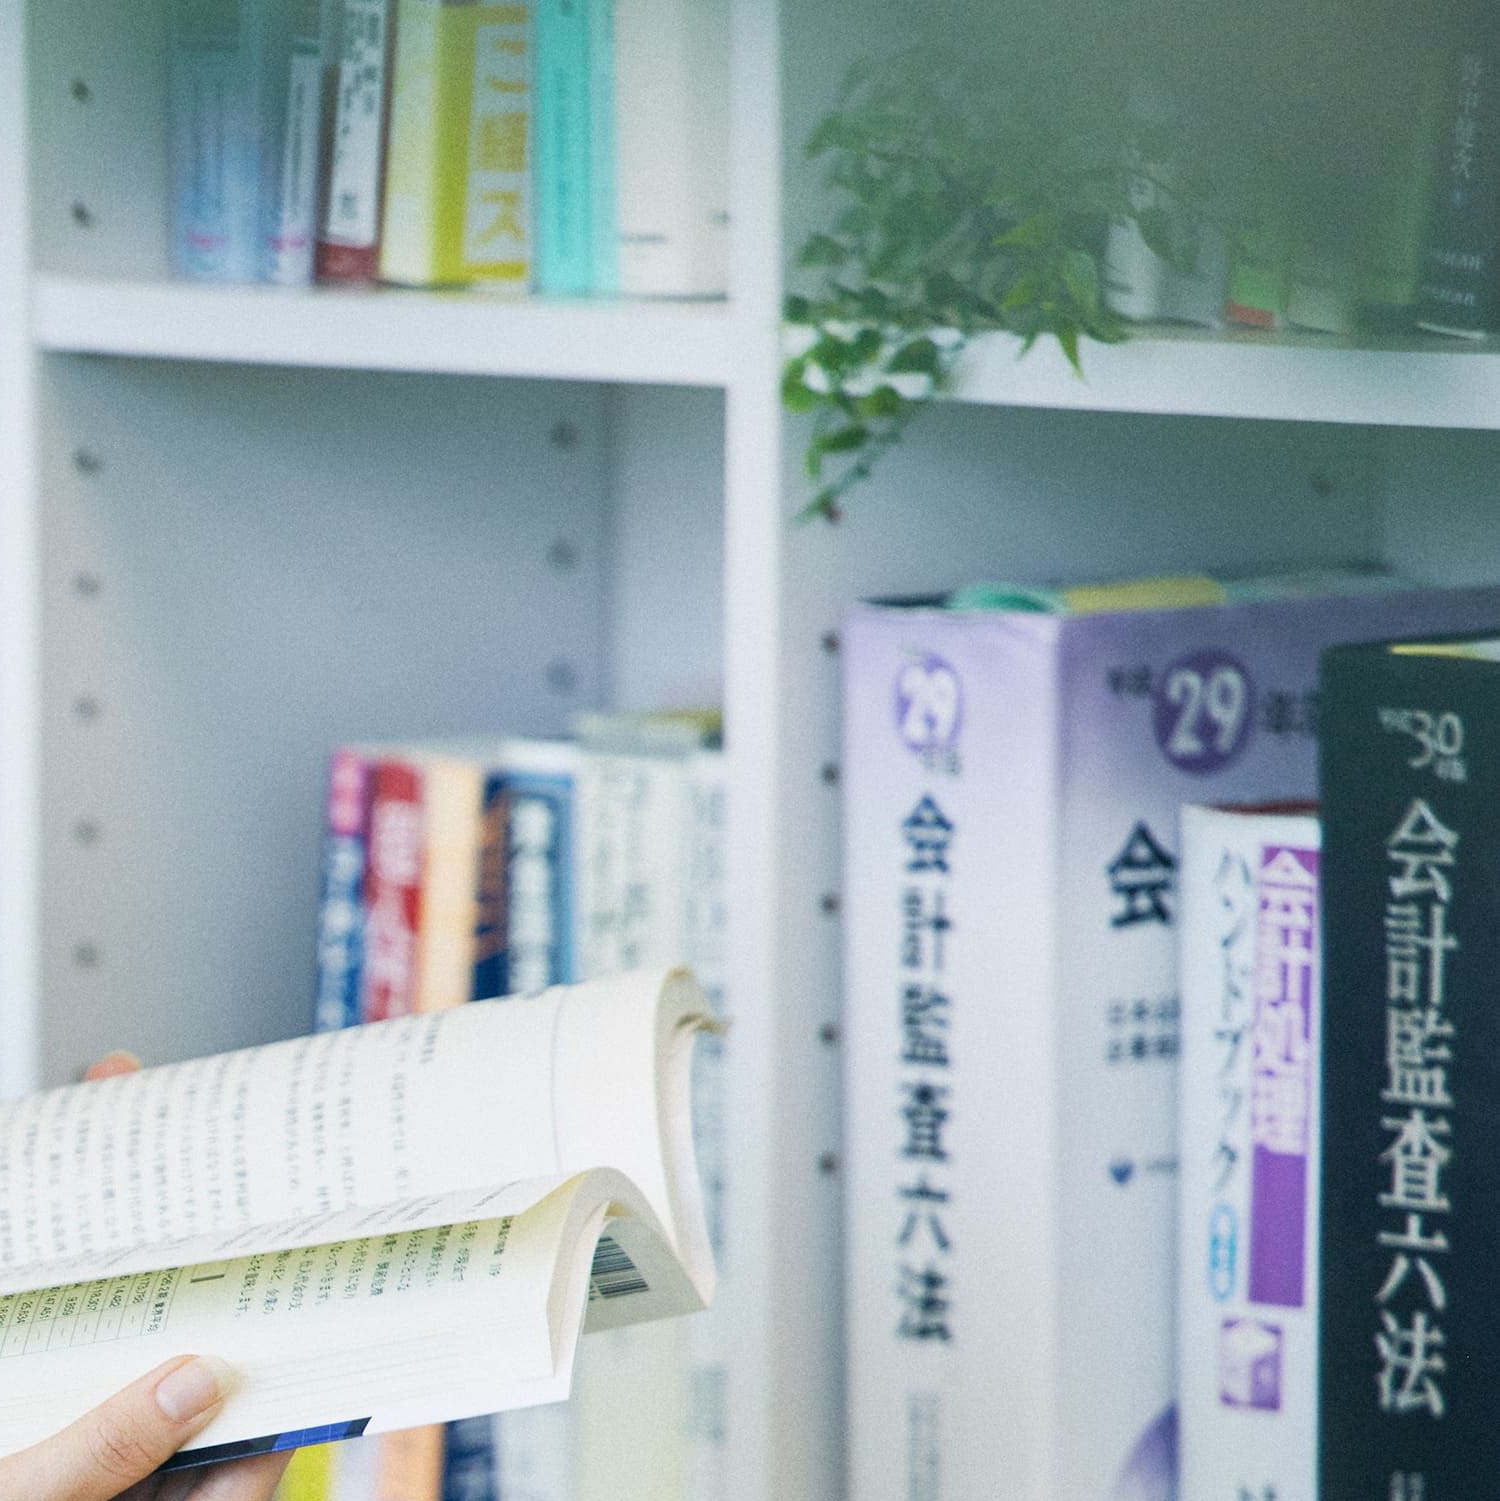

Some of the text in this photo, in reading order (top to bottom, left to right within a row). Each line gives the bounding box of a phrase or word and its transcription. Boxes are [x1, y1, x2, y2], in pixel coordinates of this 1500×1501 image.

[1165, 665, 1247, 758] 29
[1407, 709, 1464, 768] 30
[1105, 819, 1176, 928] 会
[892, 790, 958, 1345] 会計監査六法
[1374, 797, 1462, 1418] 会計監査六法
